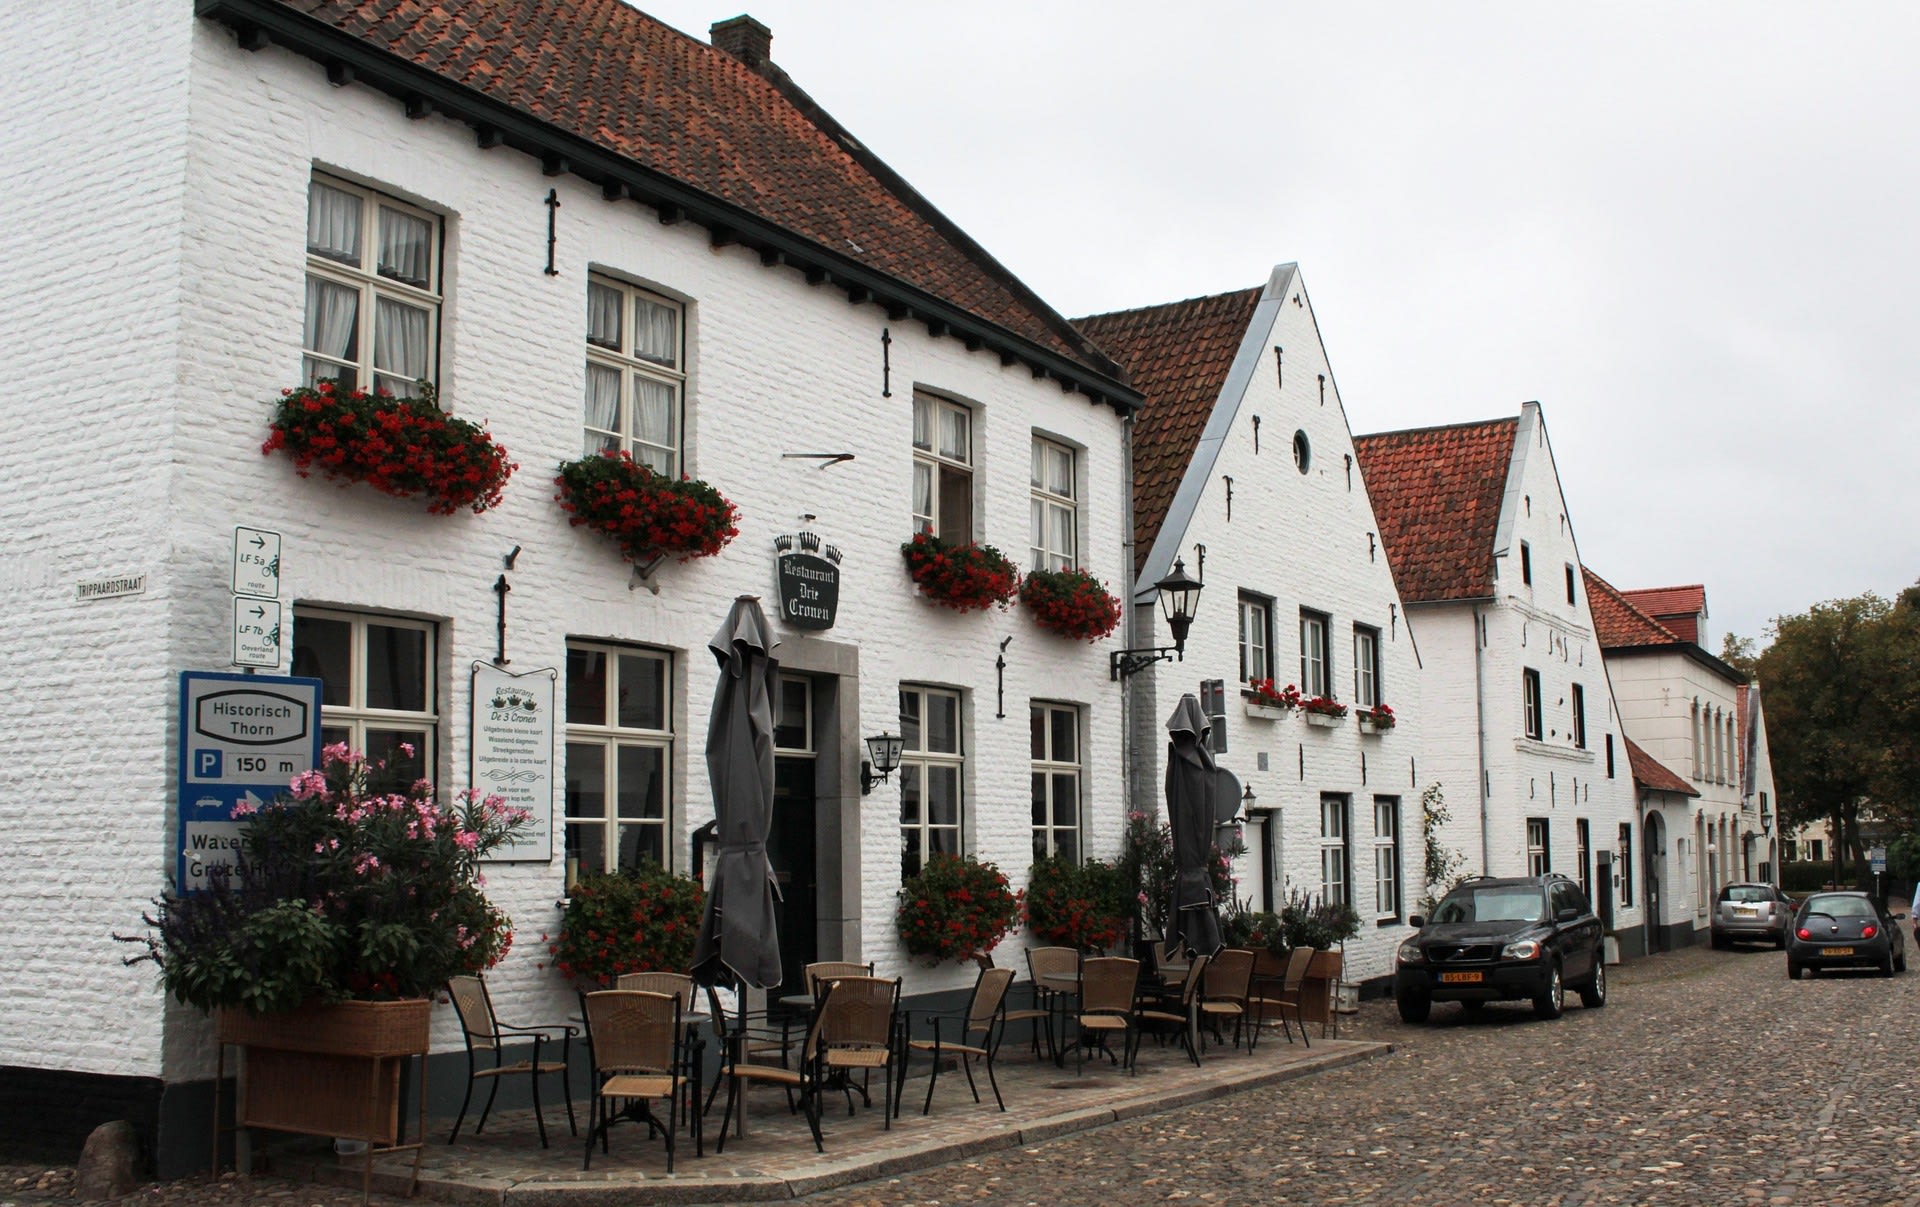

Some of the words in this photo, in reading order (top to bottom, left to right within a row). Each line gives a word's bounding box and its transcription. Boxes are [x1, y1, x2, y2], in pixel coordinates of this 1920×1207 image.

[240, 553, 252, 563] LF
[253, 555, 265, 566] 5a
[784, 559, 834, 584] Restaurant
[247, 581, 266, 589] route
[799, 582, 819, 600] Drie
[789, 598, 829, 620] Cronen
[239, 624, 251, 634] LF
[252, 625, 264, 635] 7b
[241, 644, 274, 653] Oeverland
[495, 686, 535, 699] Restaurant
[213, 702, 291, 718] Historisch
[491, 711, 502, 721] De
[502, 712, 511, 722] 3
[511, 712, 537, 724] Cronen
[230, 722, 274, 736] Thorn
[201, 752, 217, 774] P
[236, 757, 266, 773] 150
[279, 761, 294, 773] m
